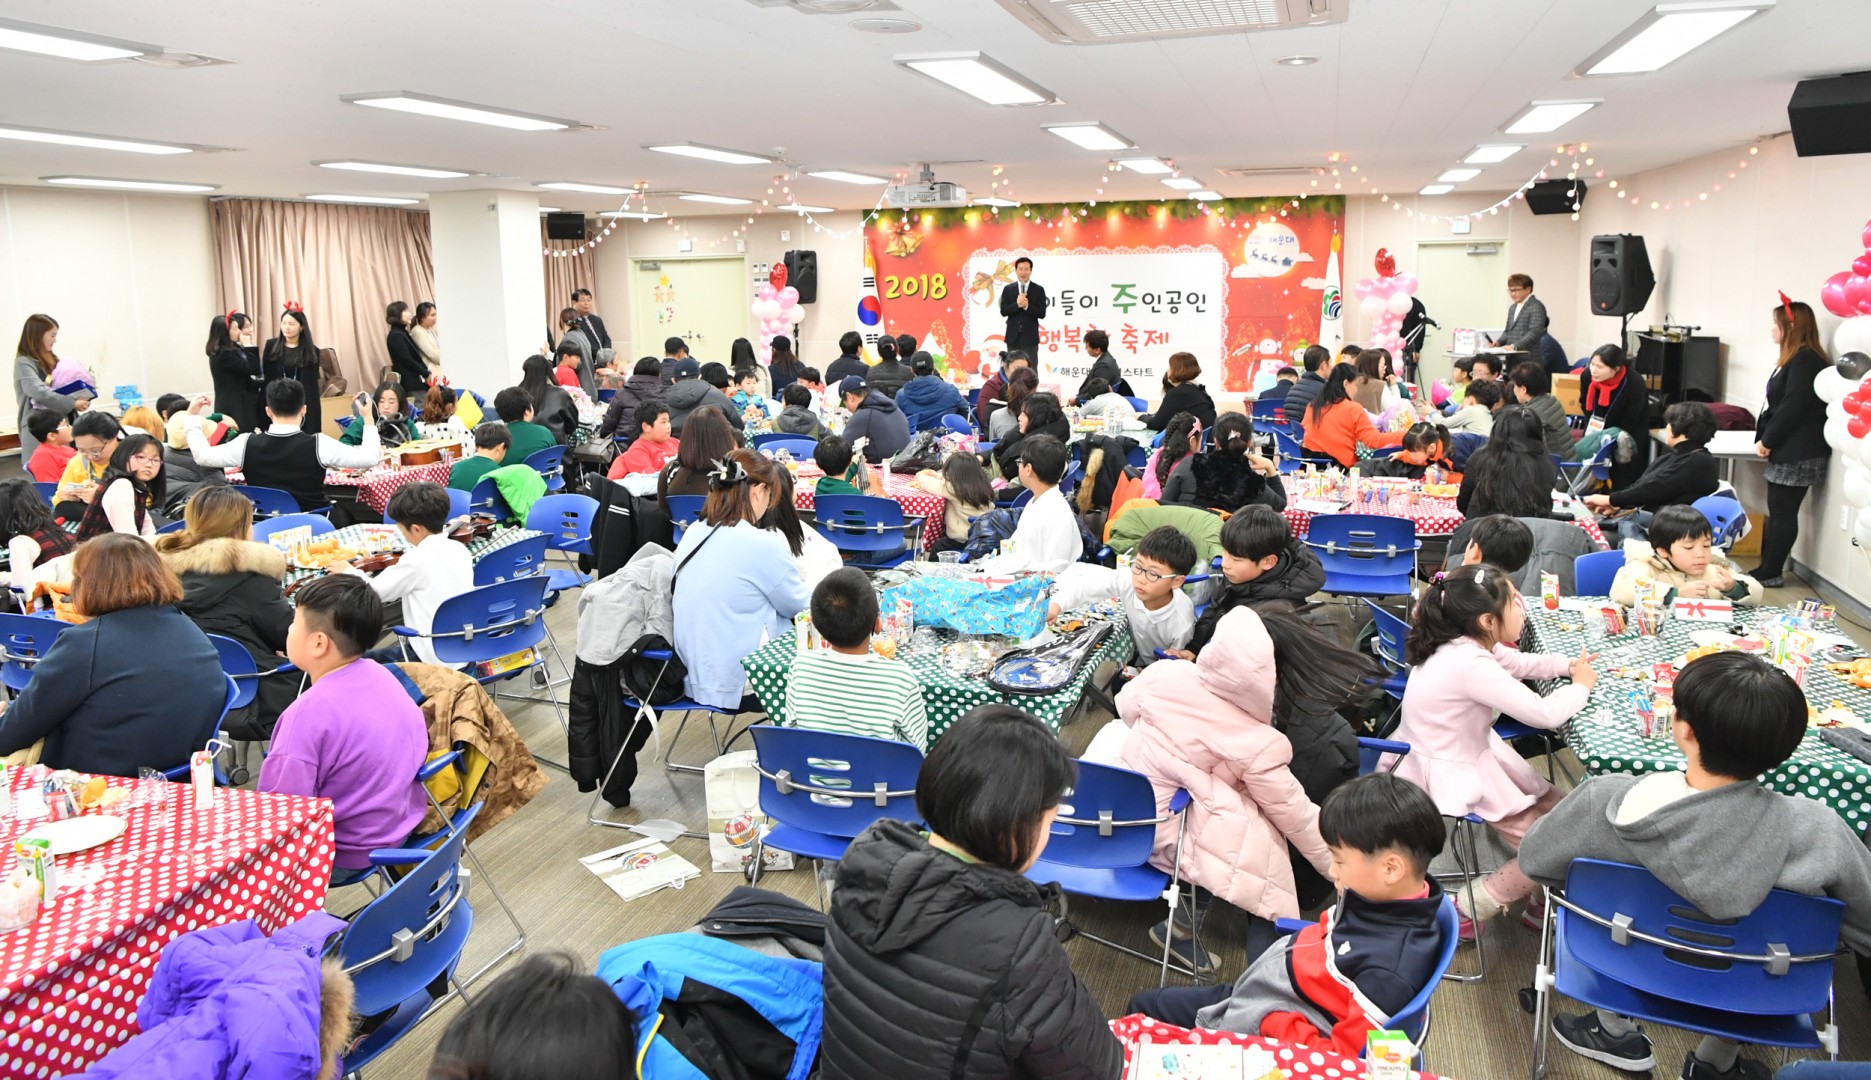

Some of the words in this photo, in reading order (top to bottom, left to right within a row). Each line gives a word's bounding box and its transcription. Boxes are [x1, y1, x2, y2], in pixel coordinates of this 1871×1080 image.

[885, 273, 947, 300] 2018
[1110, 283, 1206, 314] 주인공인
[1120, 323, 1169, 354] 축제
[1060, 367, 1091, 378] 해운대
[1119, 367, 1154, 377] 스타트
